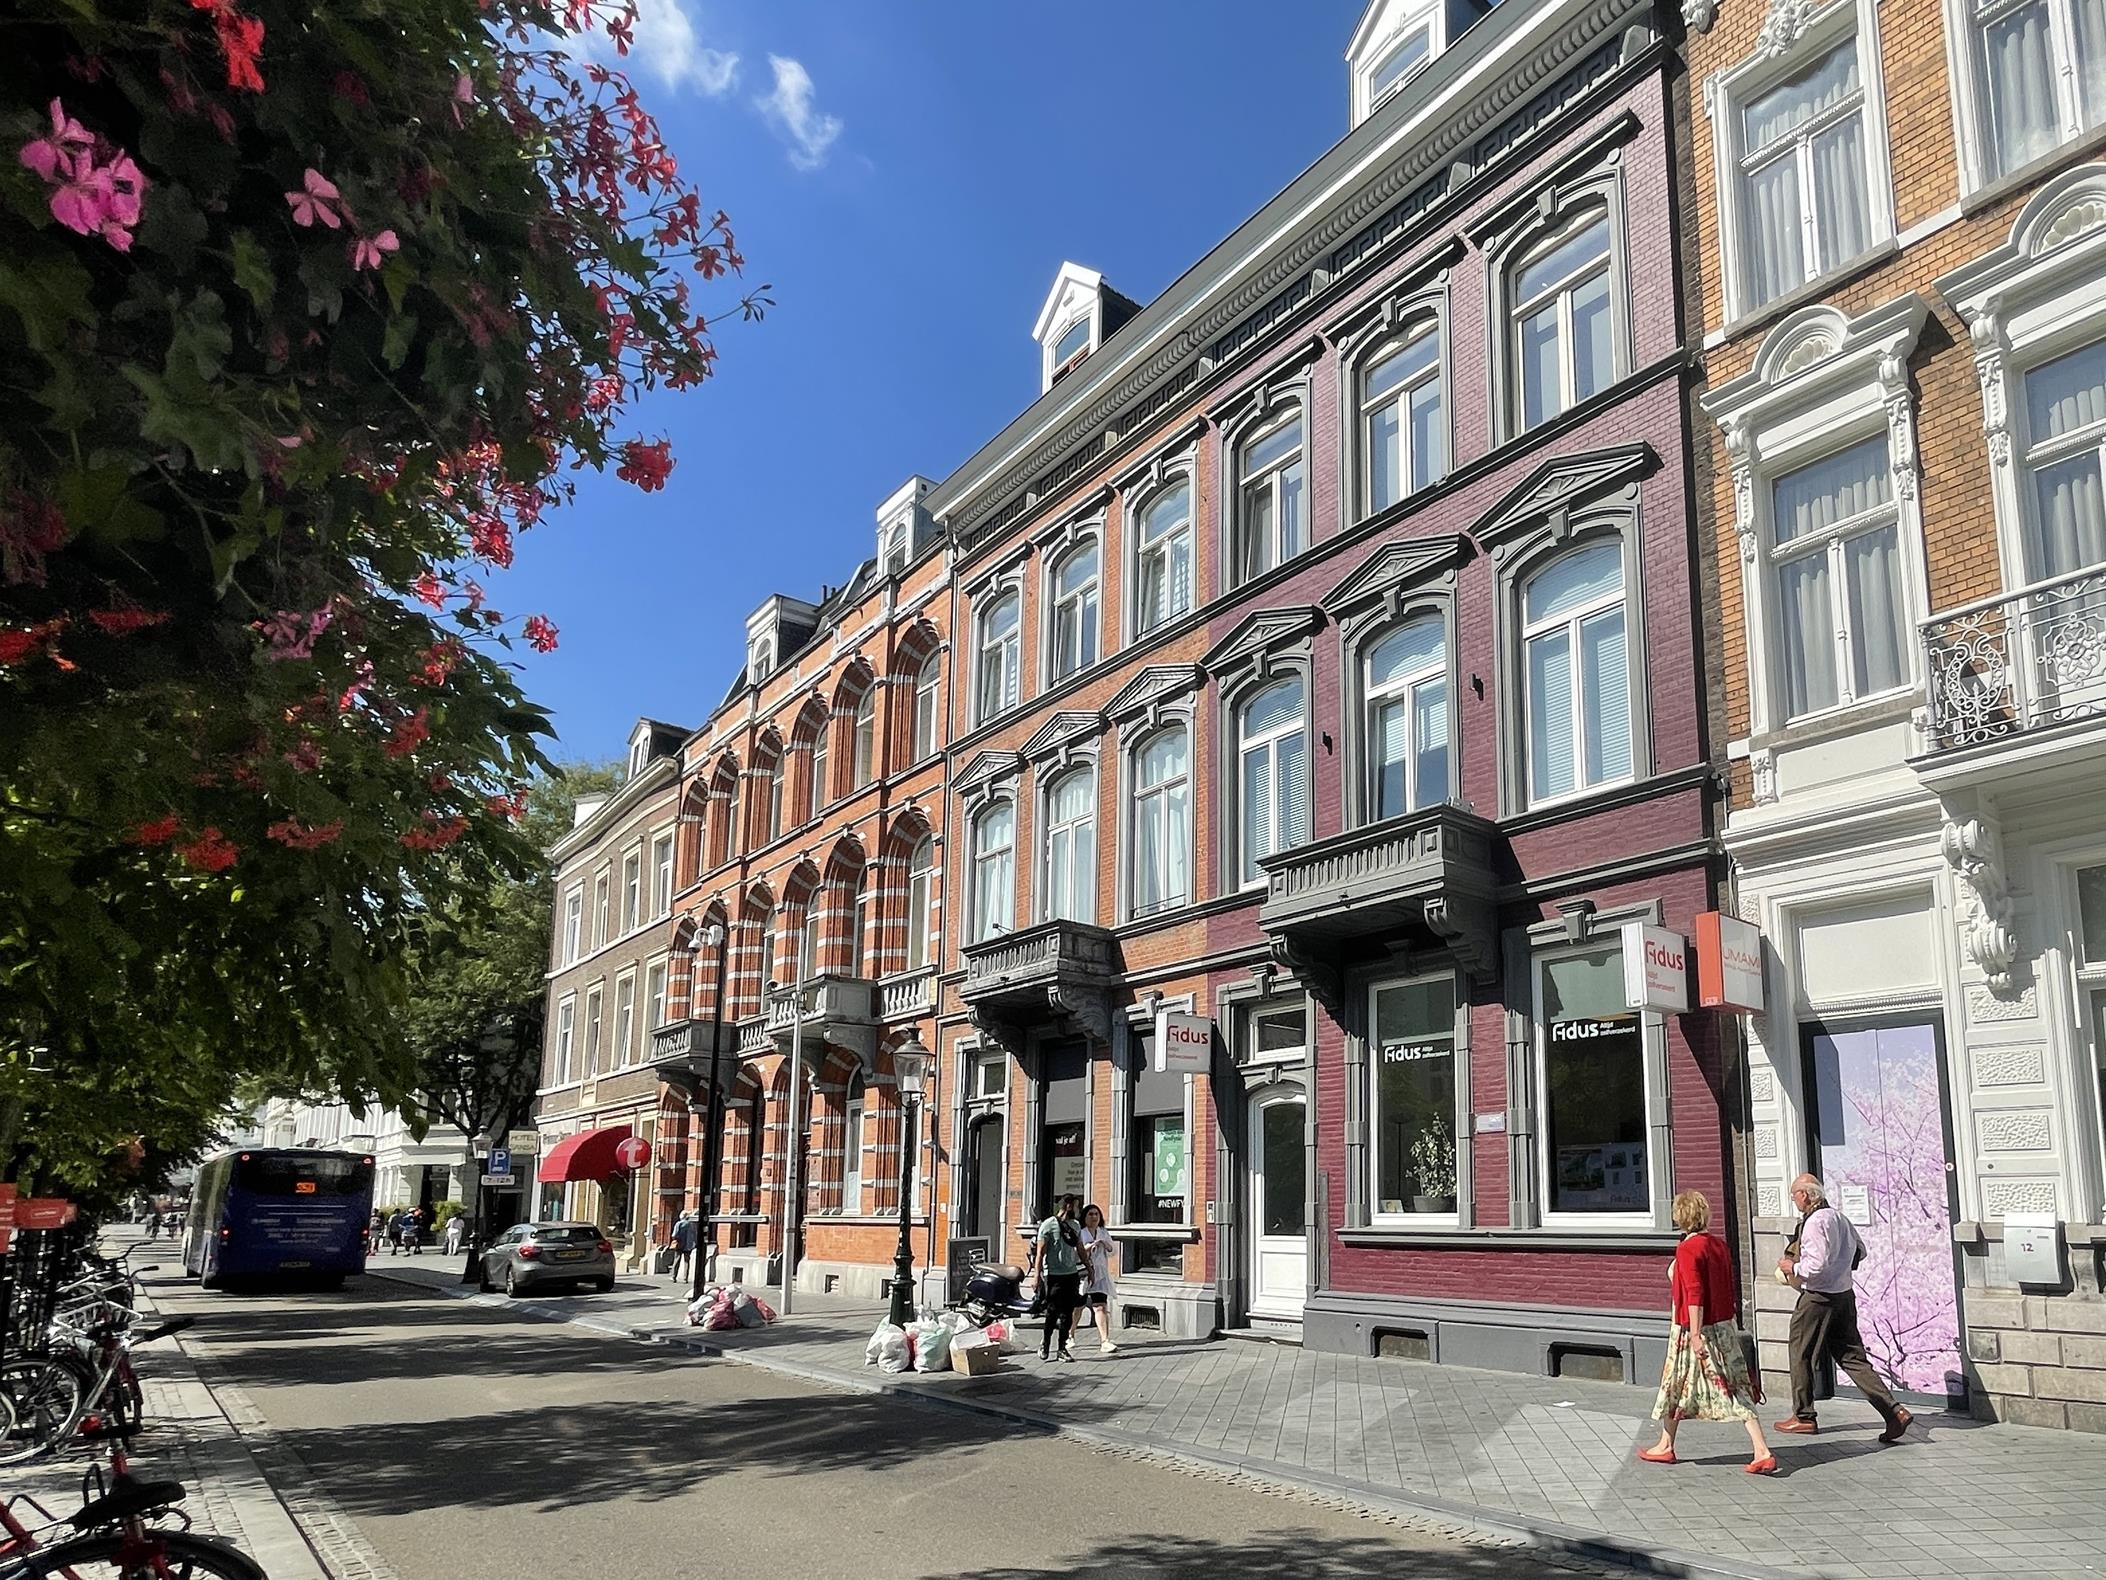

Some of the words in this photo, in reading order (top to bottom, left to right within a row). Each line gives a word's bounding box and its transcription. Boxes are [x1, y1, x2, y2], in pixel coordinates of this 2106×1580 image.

[1645, 940, 1683, 971] Fidus
[1168, 1024, 1209, 1045] Fidus
[1552, 1020, 1600, 1042] Fidus
[1384, 1044, 1421, 1063] Fidus
[511, 1134, 537, 1142] HOTEL
[494, 1151, 507, 1166] P
[624, 1142, 642, 1169] t
[2020, 1243, 2034, 1252] 12
